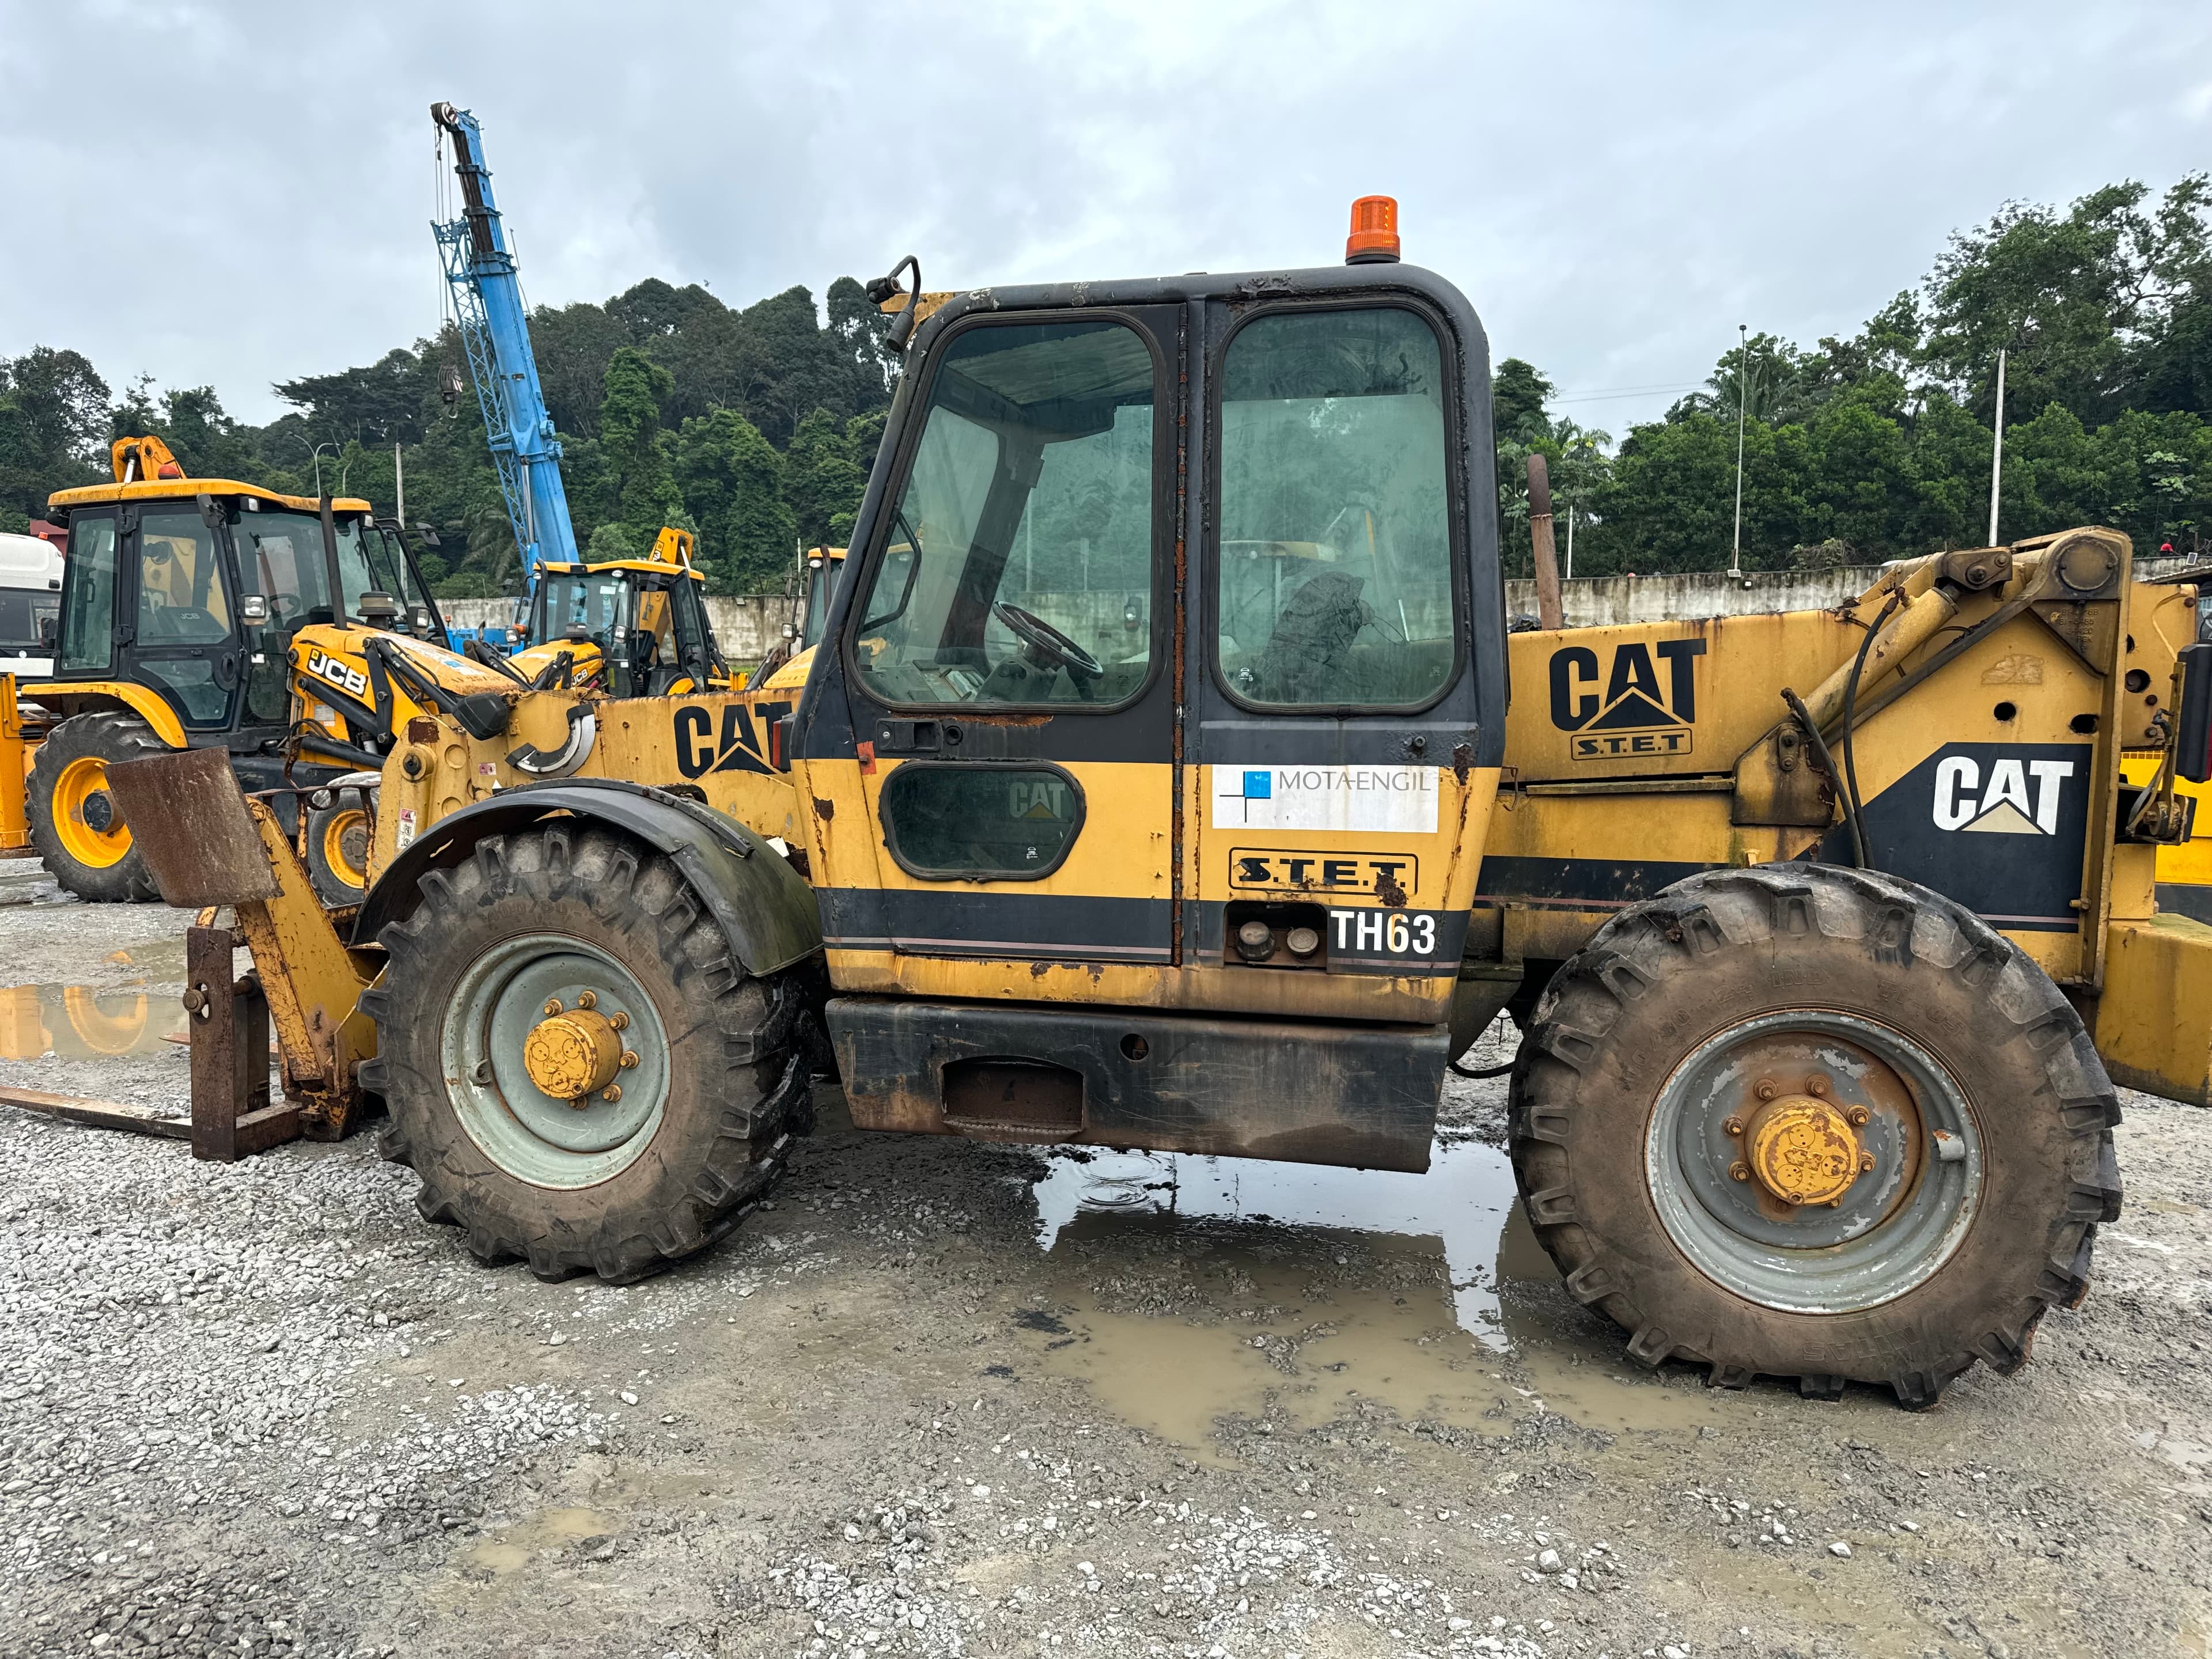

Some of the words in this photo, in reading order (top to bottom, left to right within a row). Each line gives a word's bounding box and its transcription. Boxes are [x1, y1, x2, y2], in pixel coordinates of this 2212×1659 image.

[308, 650, 367, 695] JCB
[573, 669, 588, 686] JCB
[1548, 638, 1707, 732] CAT
[673, 701, 791, 779] CAT
[1577, 733, 1685, 756] S.T.E.T
[1010, 782, 1065, 819] CAT
[1933, 756, 2074, 835] CAT
[1330, 910, 1435, 954] TH63
[1770, 968, 1827, 988] IND
[1802, 1324, 1921, 1362] MITAS
